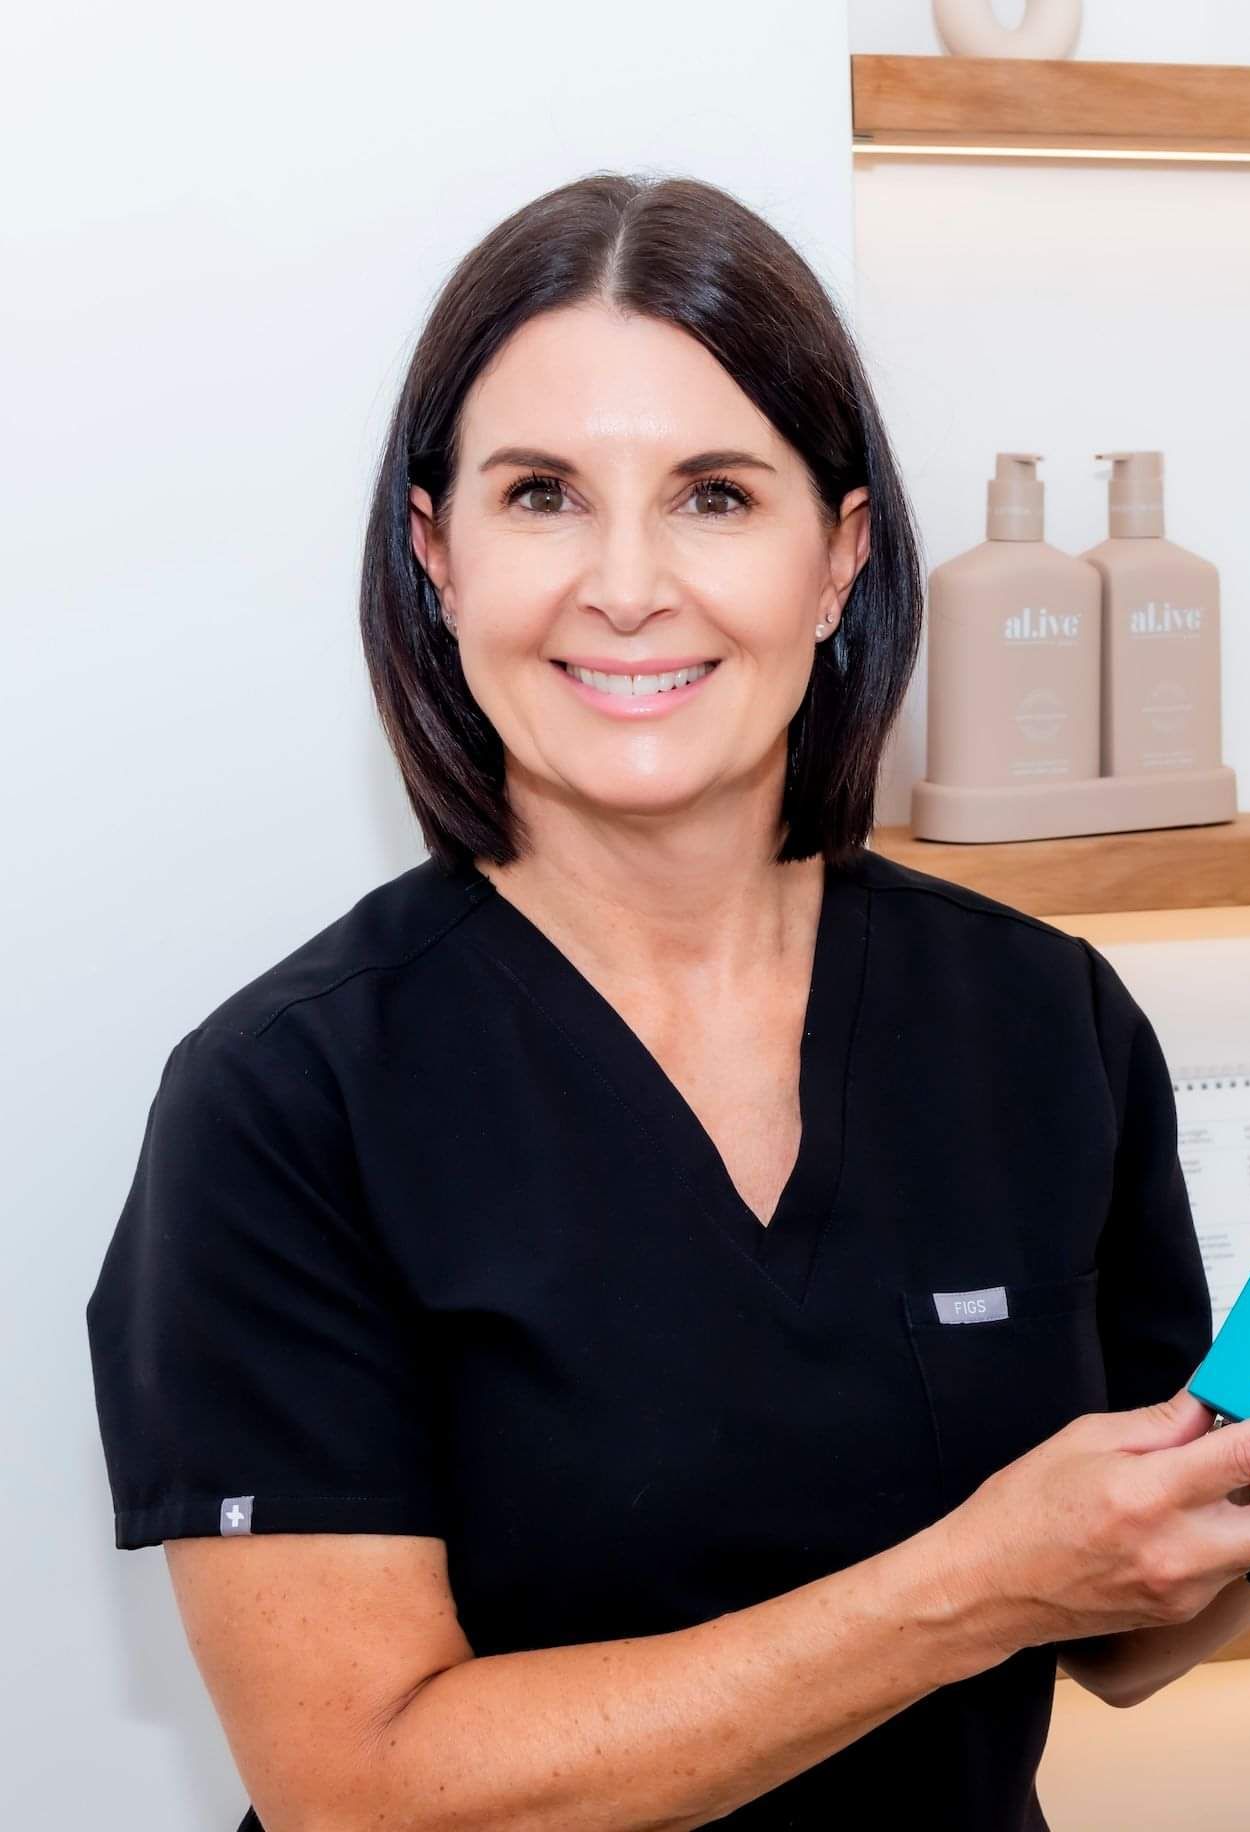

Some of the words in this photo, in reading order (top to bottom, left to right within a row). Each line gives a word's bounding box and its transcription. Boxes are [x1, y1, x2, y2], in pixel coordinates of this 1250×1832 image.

[1004, 607, 1081, 640] al.ive
[1130, 602, 1201, 633] al.ive
[954, 1299, 987, 1315] FIGS
